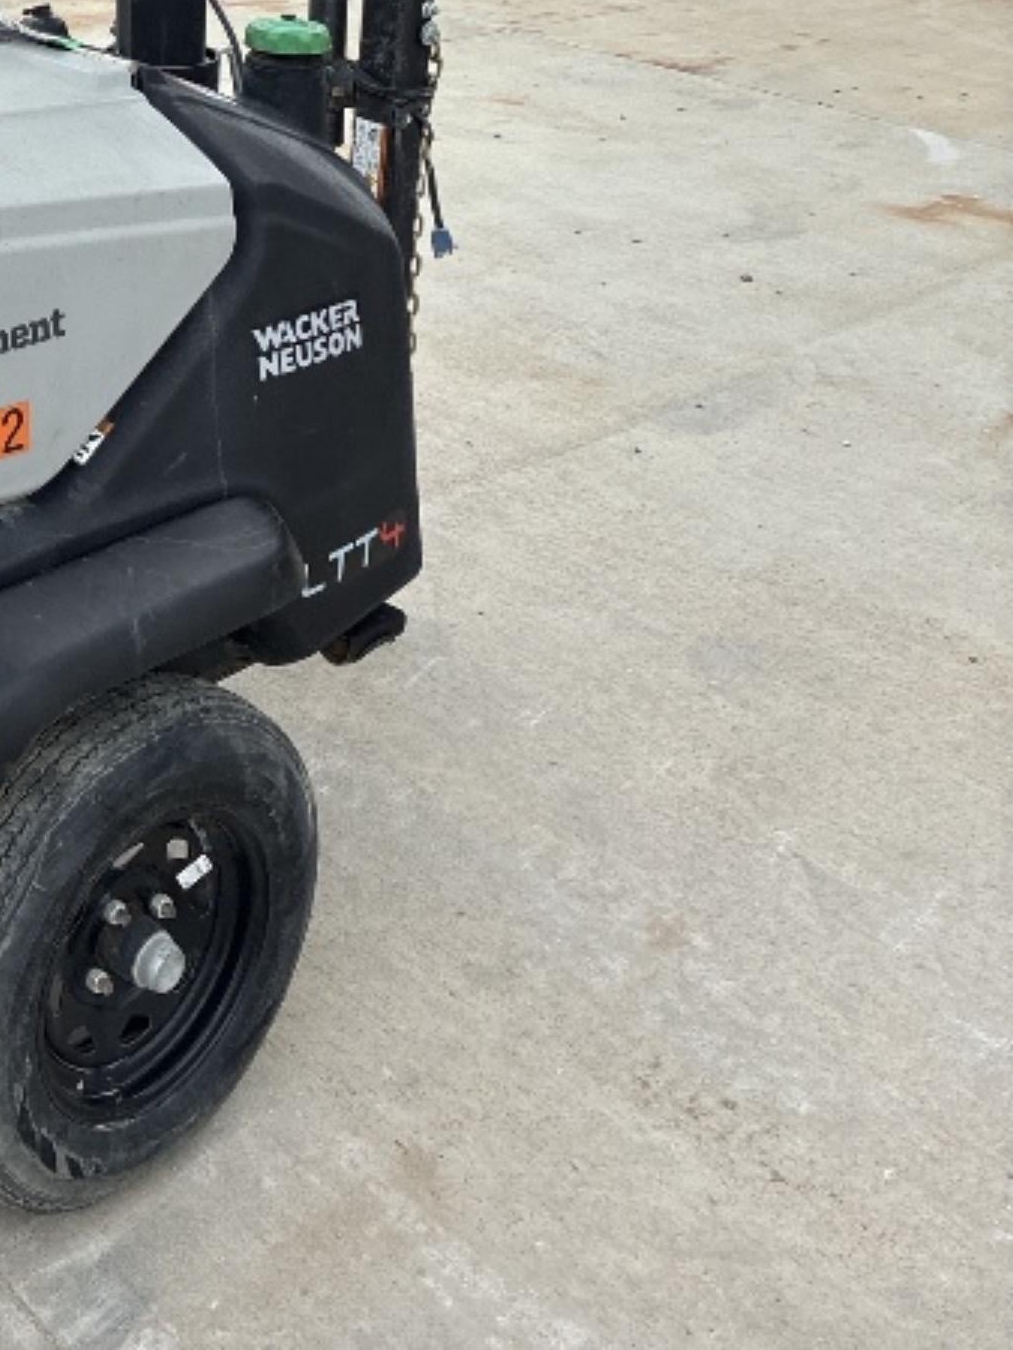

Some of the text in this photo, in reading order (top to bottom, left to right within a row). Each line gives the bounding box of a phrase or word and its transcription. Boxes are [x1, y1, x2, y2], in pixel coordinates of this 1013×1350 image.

[252, 298, 360, 352] WACKER
[258, 324, 363, 382] NEUSON
[301, 521, 405, 598] LTT4
